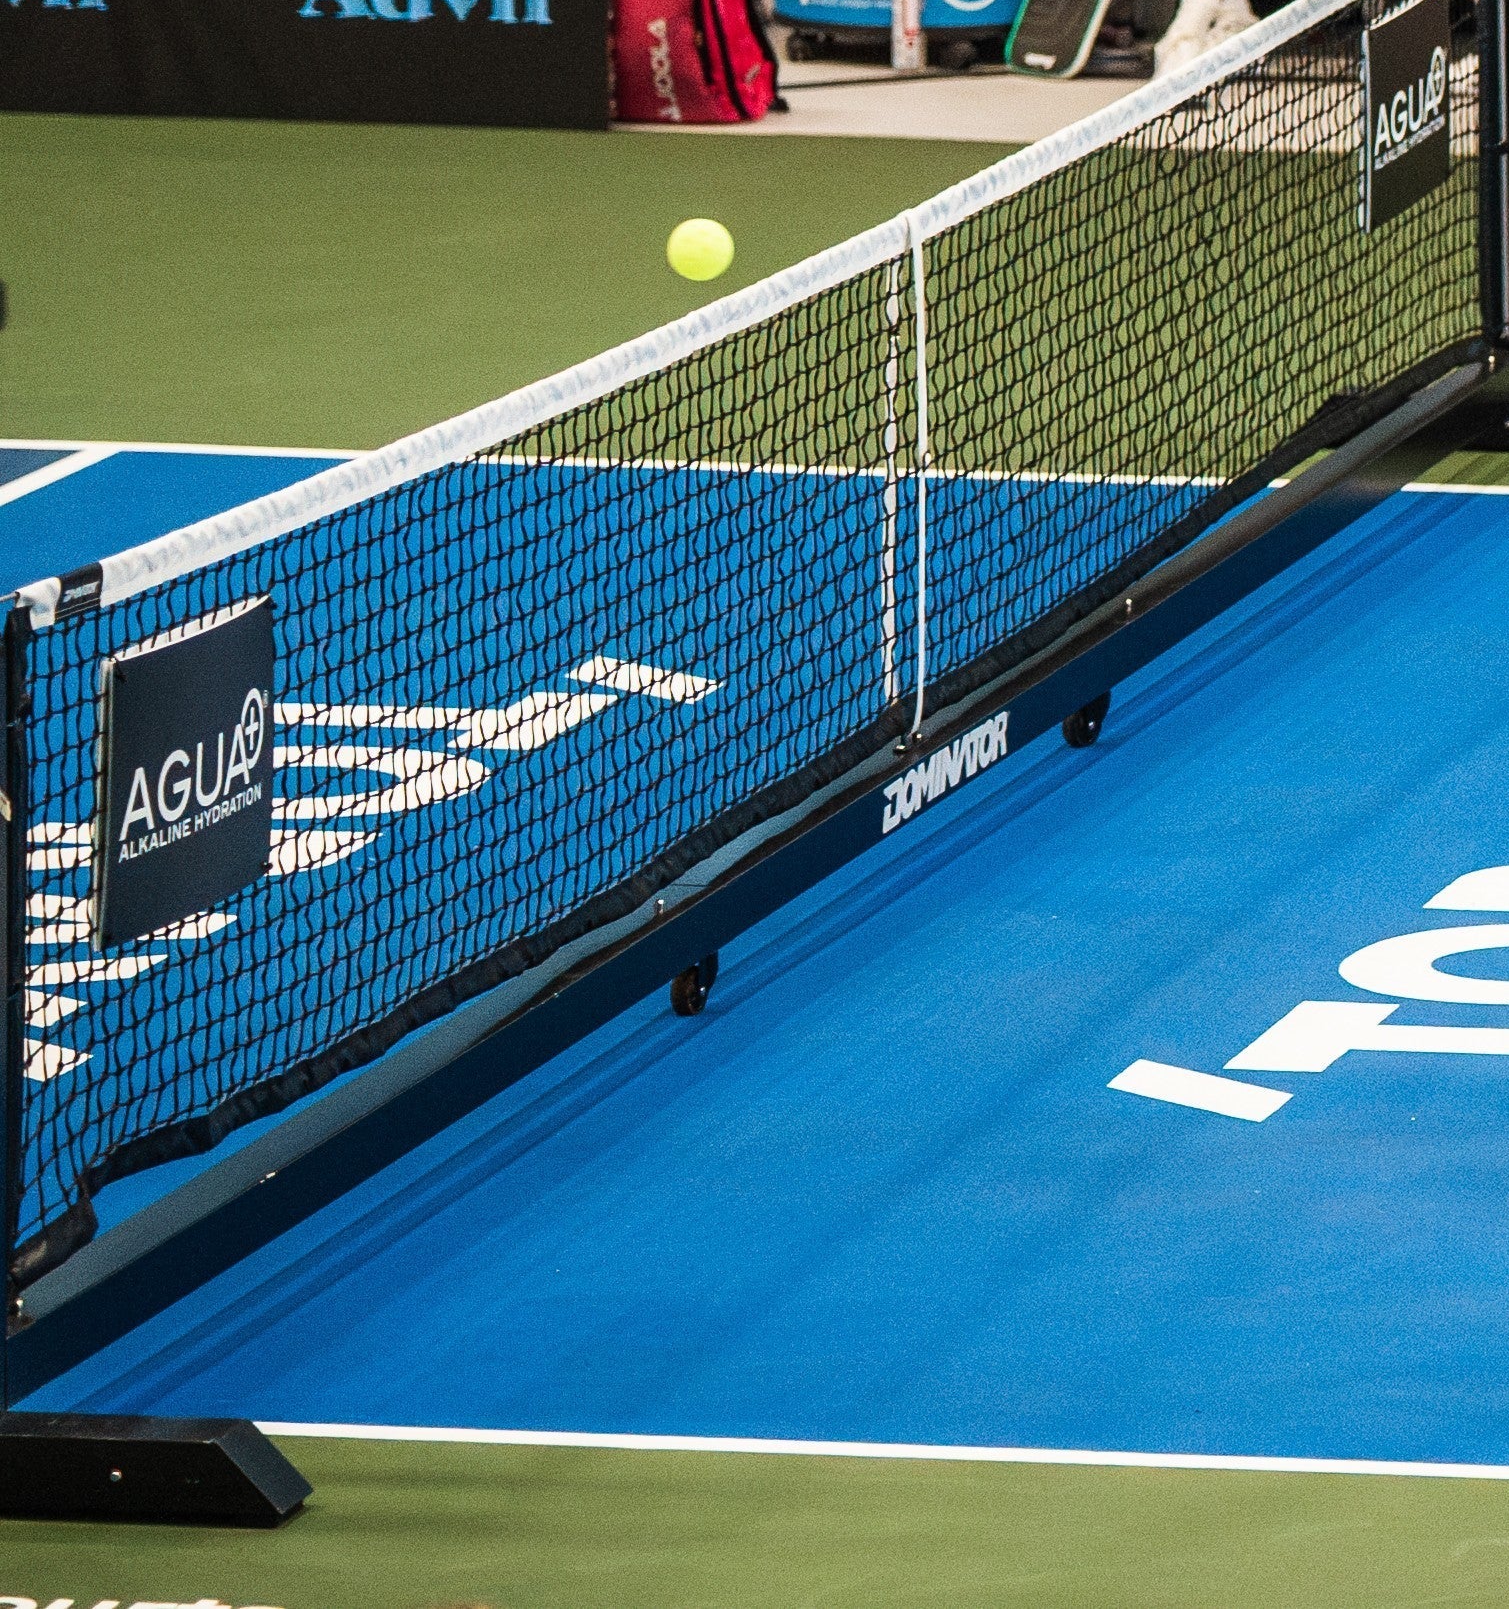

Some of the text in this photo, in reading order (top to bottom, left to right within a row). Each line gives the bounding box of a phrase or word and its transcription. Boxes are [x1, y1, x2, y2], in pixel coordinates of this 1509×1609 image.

[118, 782, 262, 864] ALKALINE HYDRATION
[882, 711, 1011, 834] DOMINATOR
